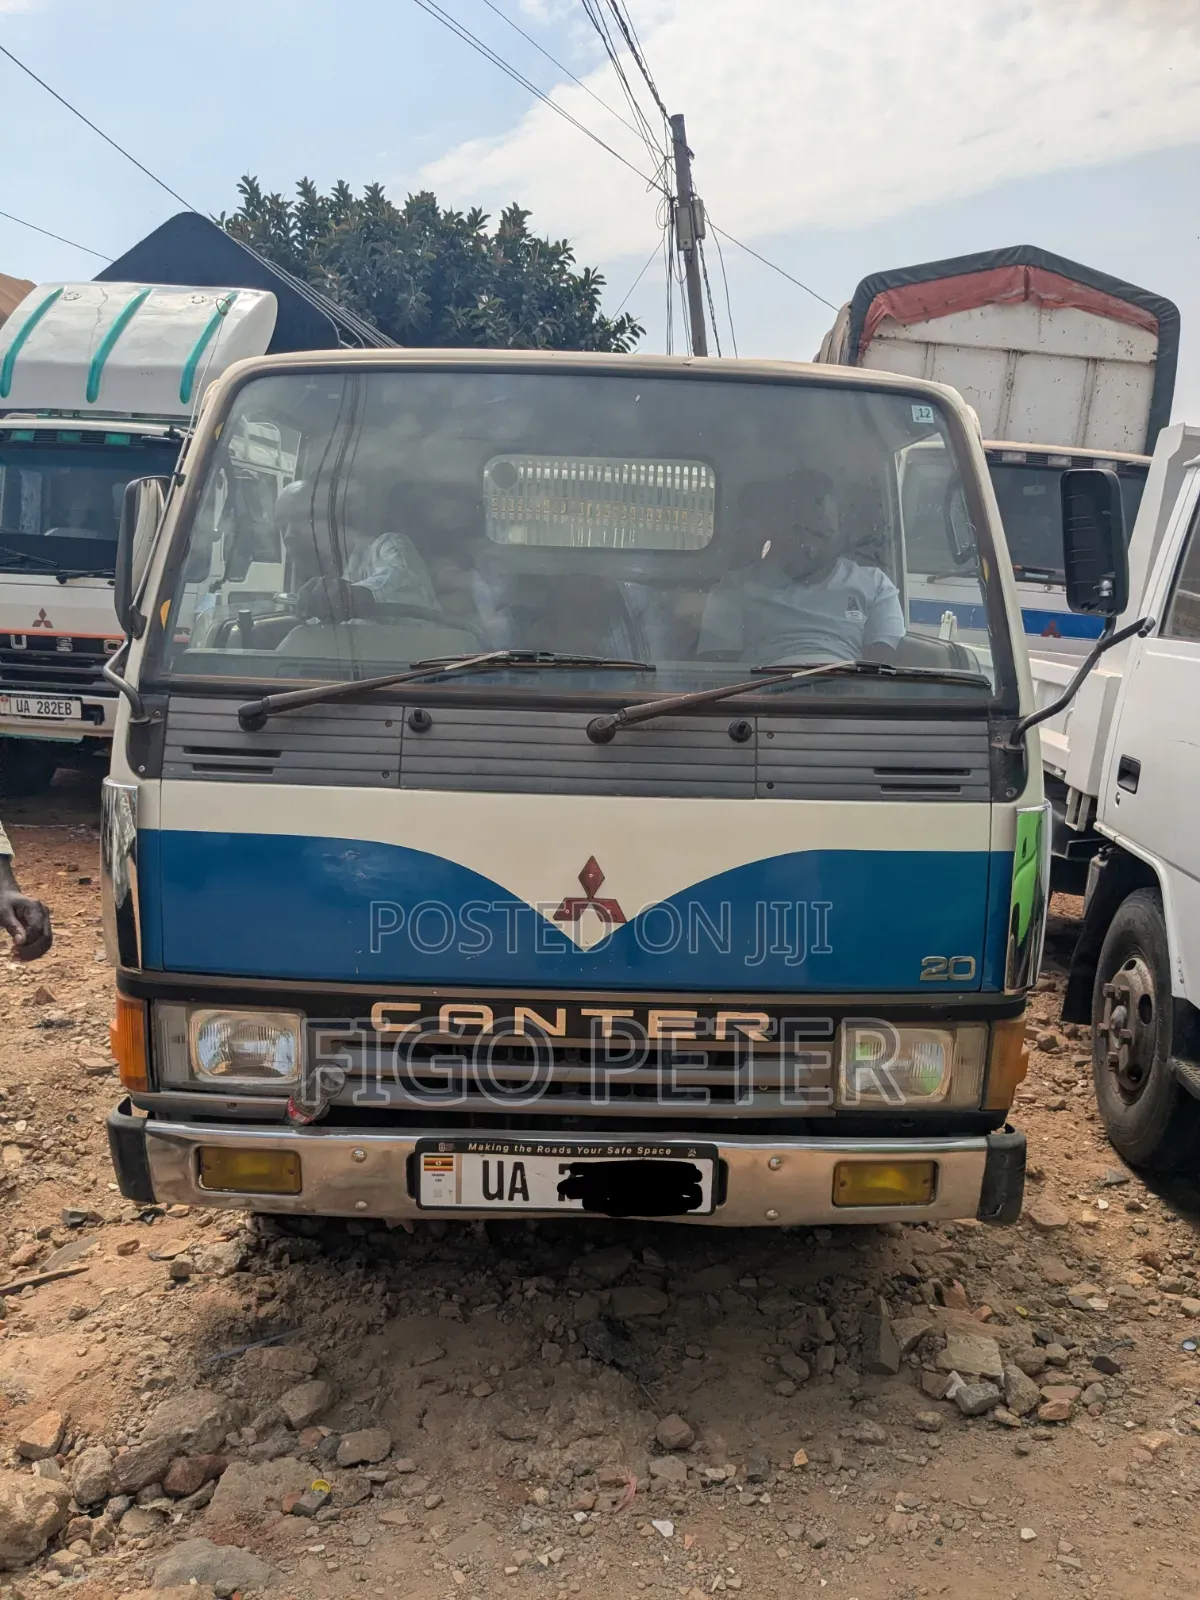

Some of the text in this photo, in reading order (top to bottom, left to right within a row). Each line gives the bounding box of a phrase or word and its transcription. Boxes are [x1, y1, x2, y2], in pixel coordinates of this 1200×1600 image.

[918, 407, 932, 419] 12
[16, 699, 72, 716] UA 282EB
[920, 955, 976, 981] 20
[371, 1002, 773, 1042] CANTER
[468, 1142, 672, 1156] Making the Roads Your Safe Space
[482, 1160, 530, 1202] UA
